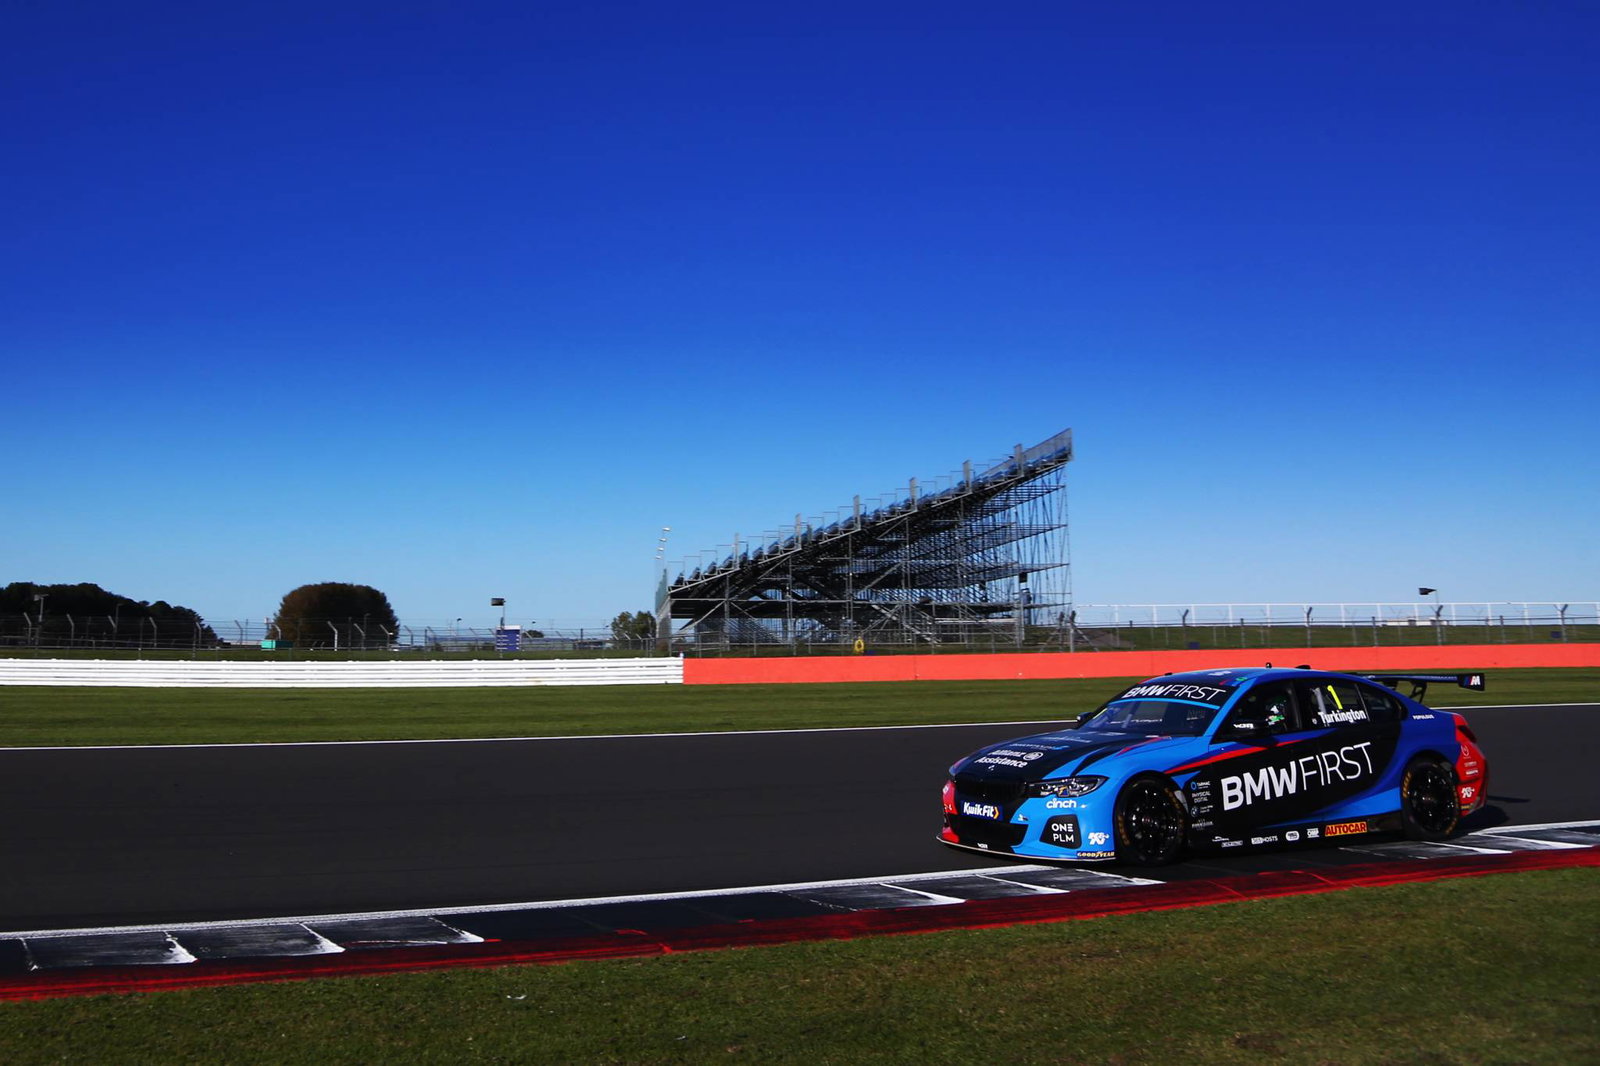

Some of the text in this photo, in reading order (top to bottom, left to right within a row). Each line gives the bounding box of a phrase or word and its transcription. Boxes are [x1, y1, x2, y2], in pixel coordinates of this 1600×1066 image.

[1318, 708, 1367, 724] Turkington
[974, 756, 1028, 768] Assistance
[1046, 798, 1077, 809] cinch
[1051, 823, 1074, 832] ONE
[1325, 822, 1367, 837] AUTOCAR
[1053, 833, 1075, 843] PLM
